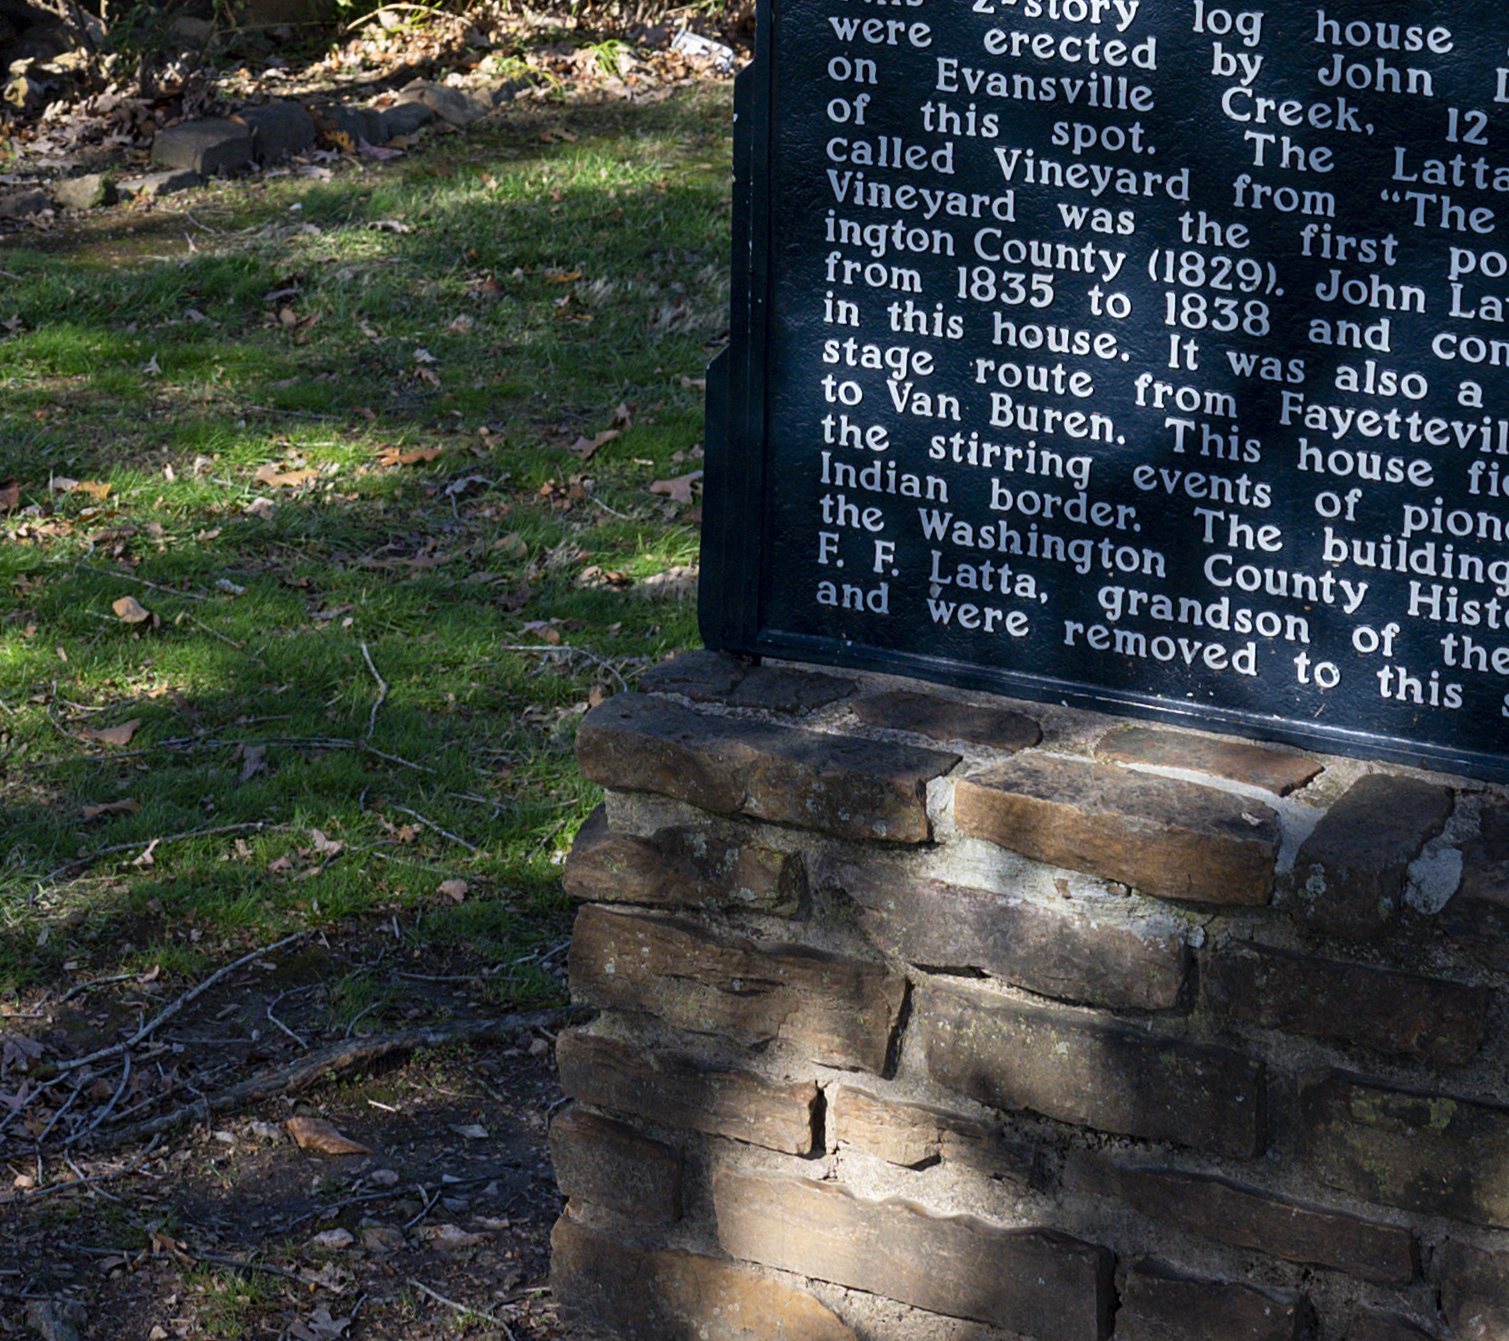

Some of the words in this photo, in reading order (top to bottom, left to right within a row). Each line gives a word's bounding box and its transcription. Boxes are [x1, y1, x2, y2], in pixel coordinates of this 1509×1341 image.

[827, 16, 933, 48] were
[983, 27, 1158, 71] erected
[1210, 41, 1264, 87] by
[1317, 53, 1434, 97] John
[1314, 9, 1454, 54] house
[826, 92, 871, 125] of
[919, 100, 999, 139] this
[1051, 121, 1156, 155] spot.
[1243, 129, 1335, 173] The
[827, 56, 878, 85] on
[935, 56, 1155, 112] Evansville
[1221, 86, 1374, 135] Creek,
[1445, 107, 1488, 145] 12
[826, 135, 955, 175] called
[993, 145, 1190, 201] Vineyard
[1232, 173, 1336, 218] from
[1380, 189, 1495, 234] "The
[826, 168, 1016, 223] Vineyard
[1056, 202, 1135, 236] was
[1178, 210, 1250, 249] the
[1299, 223, 1399, 266] first
[824, 208, 955, 258] ington
[973, 227, 1127, 283] County
[1147, 247, 1284, 296] (1829).
[1315, 269, 1426, 314] John
[824, 250, 923, 293] from
[957, 265, 1054, 308] 1835
[1087, 283, 1132, 319] to
[1164, 291, 1270, 337] 1838
[1308, 317, 1391, 353] and
[822, 289, 860, 328] in
[886, 299, 964, 340] this
[991, 310, 1136, 363] house.
[1167, 333, 1200, 371] It
[1225, 350, 1305, 384] was
[1334, 359, 1428, 400] also
[1457, 380, 1484, 409] a
[822, 336, 935, 381] stage
[975, 357, 1094, 398] route
[1133, 371, 1238, 418] from
[820, 372, 863, 406] to
[885, 378, 962, 422] Van
[989, 391, 1126, 446] Buren.
[1164, 416, 1261, 463] This
[1296, 437, 1435, 487] house
[820, 413, 890, 452] the
[928, 431, 1093, 491] stirring
[1133, 464, 1272, 509] events
[1314, 487, 1363, 522] of
[820, 450, 949, 504] Indian
[989, 477, 1141, 532] border.
[1193, 506, 1284, 552] The
[817, 531, 845, 568] F.
[872, 539, 899, 577] F.
[928, 549, 1049, 605] Latta,
[1097, 585, 1311, 644] grandson
[1351, 621, 1401, 658] of
[819, 493, 885, 532] the
[917, 507, 1166, 578] Washington
[1203, 553, 1369, 615] County
[816, 580, 890, 614] and
[926, 598, 1030, 637] were
[1063, 620, 1258, 677] removed
[1293, 651, 1341, 695] to
[1376, 664, 1463, 709] this
